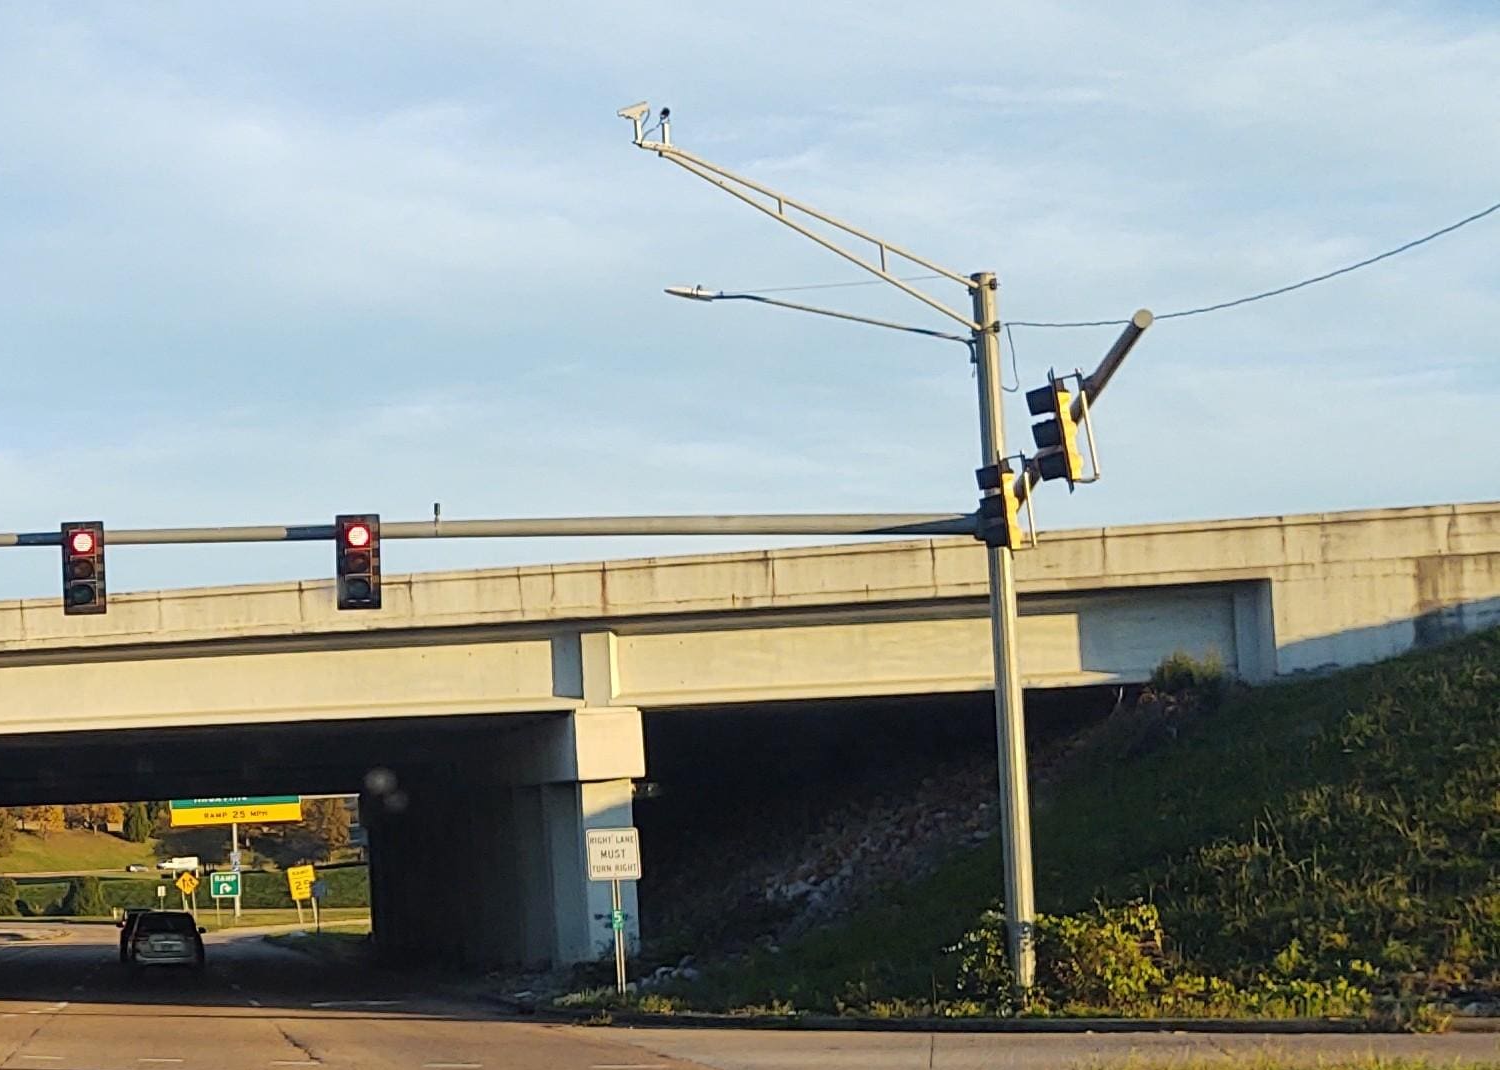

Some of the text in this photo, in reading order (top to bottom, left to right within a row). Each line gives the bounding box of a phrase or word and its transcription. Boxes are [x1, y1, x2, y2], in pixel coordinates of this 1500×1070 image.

[203, 811, 228, 819] RAMP
[232, 810, 246, 819] 25
[590, 835, 635, 844] RIGHT LANE
[600, 848, 626, 859] MUST
[592, 863, 637, 873] TURN RIGHT
